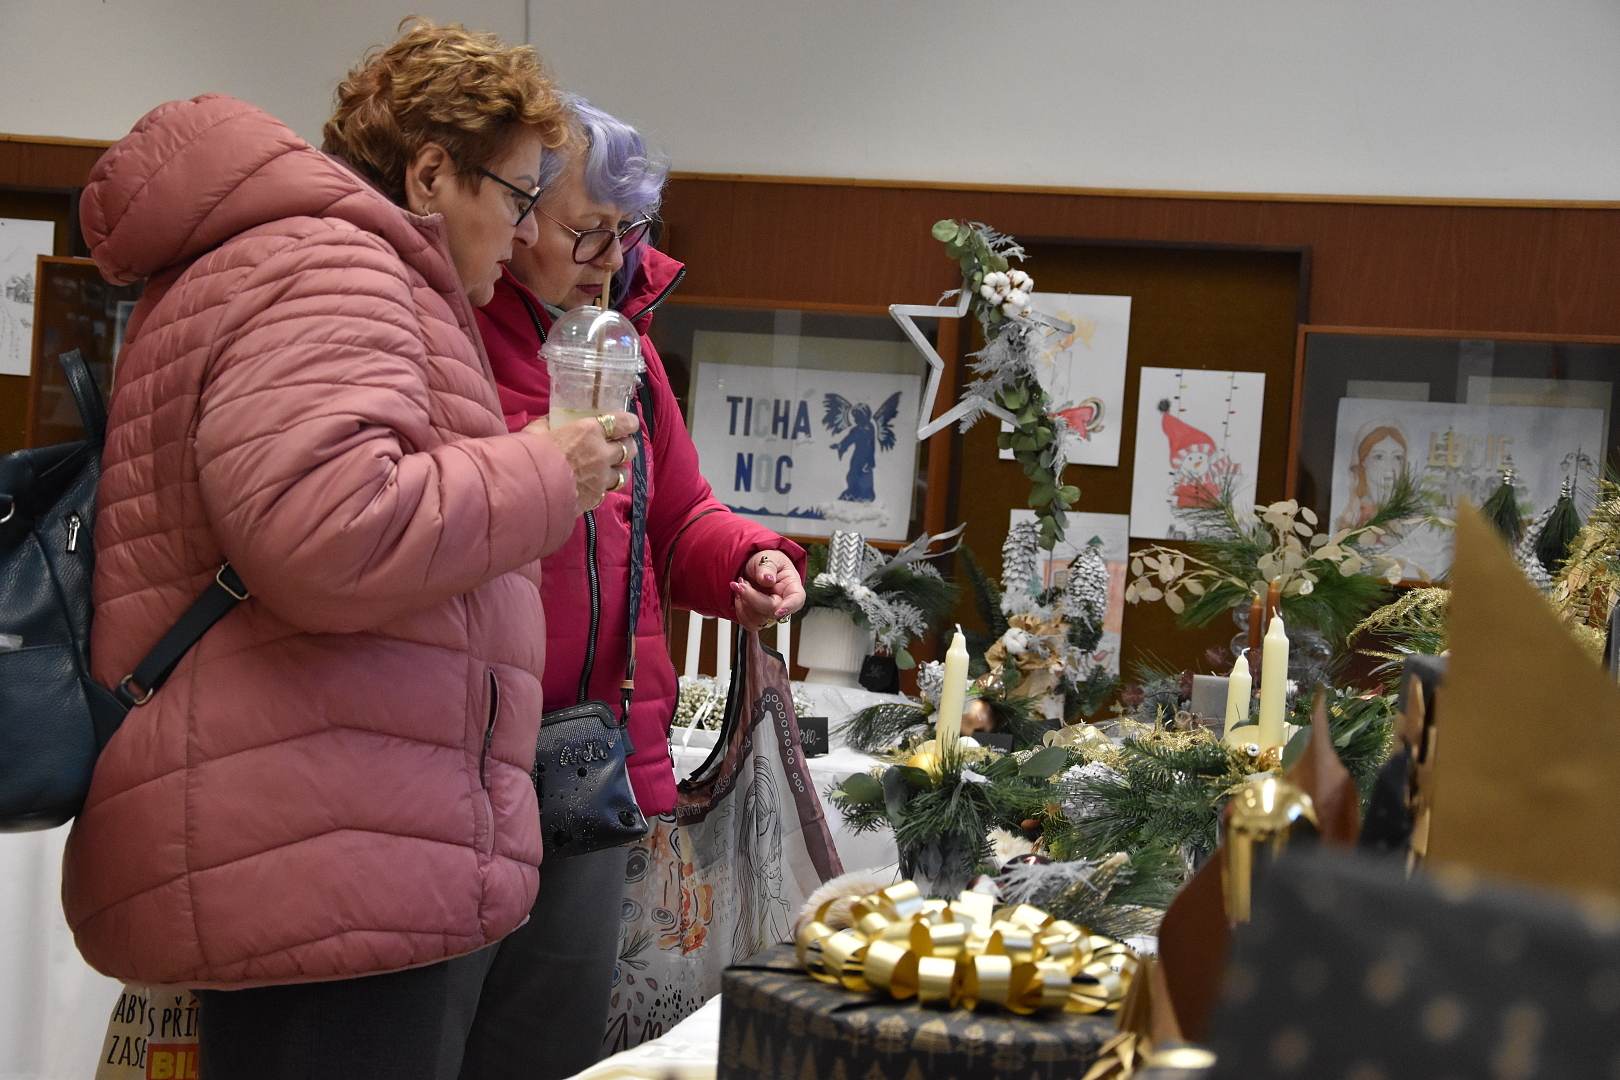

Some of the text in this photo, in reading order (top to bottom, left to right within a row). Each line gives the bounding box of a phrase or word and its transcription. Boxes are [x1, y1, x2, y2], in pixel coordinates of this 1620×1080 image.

[726, 387, 816, 440] TICHÁ
[1428, 431, 1514, 471] LUCIE
[734, 452, 793, 495] NOC
[161, 996, 199, 1038] PŘÍ
[151, 1051, 199, 1080] BIL
